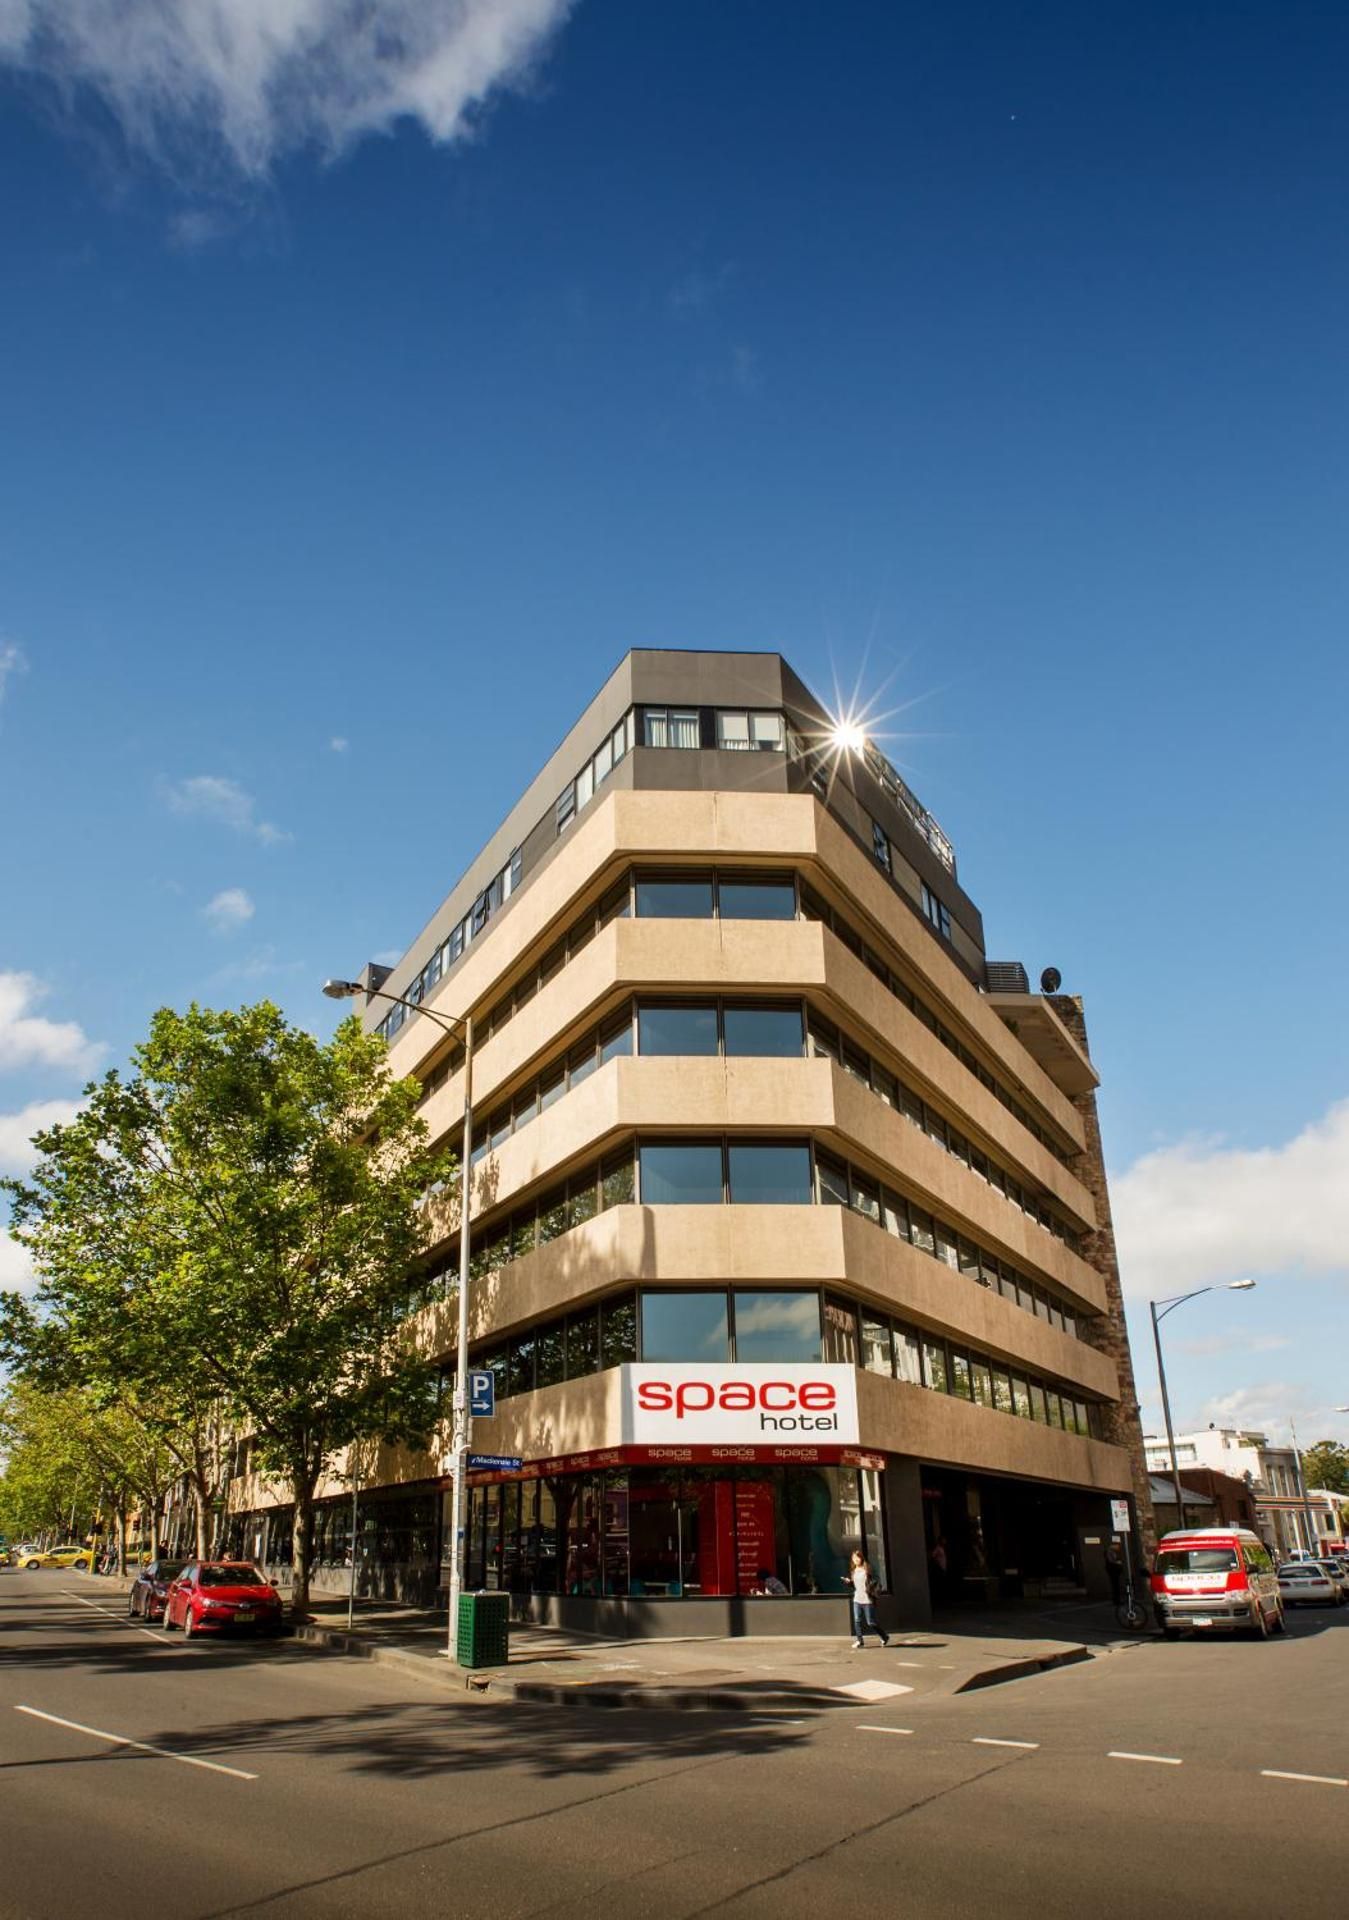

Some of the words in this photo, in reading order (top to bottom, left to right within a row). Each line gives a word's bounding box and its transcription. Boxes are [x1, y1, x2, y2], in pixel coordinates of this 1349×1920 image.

[473, 1375, 489, 1398] P
[638, 1381, 836, 1418] space
[760, 1412, 838, 1431] hotel
[648, 1447, 692, 1458] space
[712, 1447, 755, 1458] space
[775, 1447, 818, 1458] space
